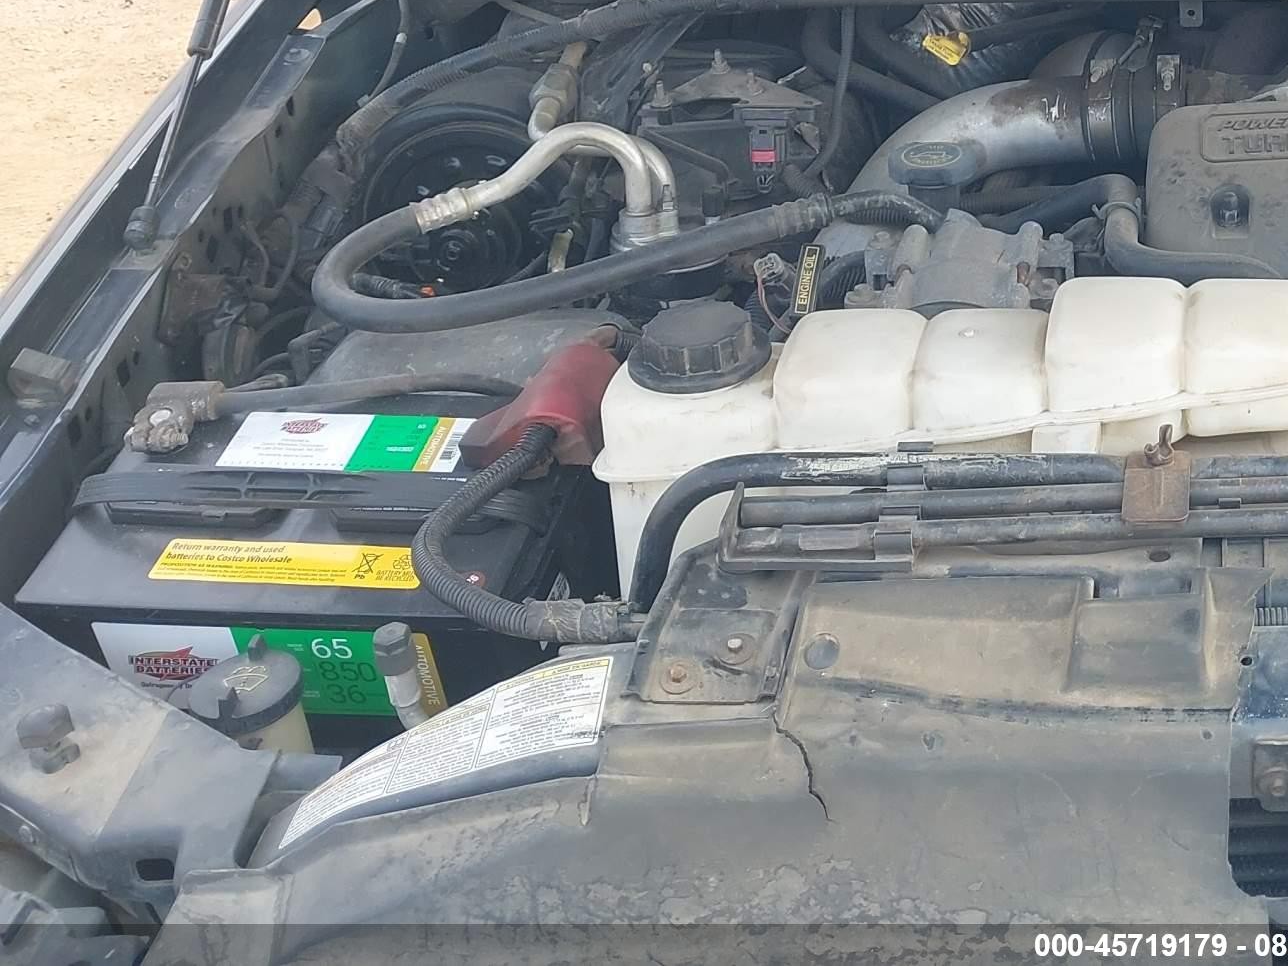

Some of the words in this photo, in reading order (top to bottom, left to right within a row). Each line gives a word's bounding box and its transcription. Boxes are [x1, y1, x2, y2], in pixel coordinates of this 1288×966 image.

[804, 253, 816, 269] OIL
[798, 270, 812, 305] ENGINE
[172, 542, 202, 550] Return
[203, 544, 242, 553] warranty
[244, 545, 261, 553] and
[262, 545, 285, 553] used
[166, 552, 204, 560] batteries
[217, 554, 245, 562] Costco
[247, 554, 293, 564] Wholesale
[311, 638, 353, 659] 65
[128, 655, 216, 666] INTERSTATE
[318, 661, 378, 682] 850
[415, 645, 441, 705] AUTOMOTIVE
[326, 684, 368, 704] 36
